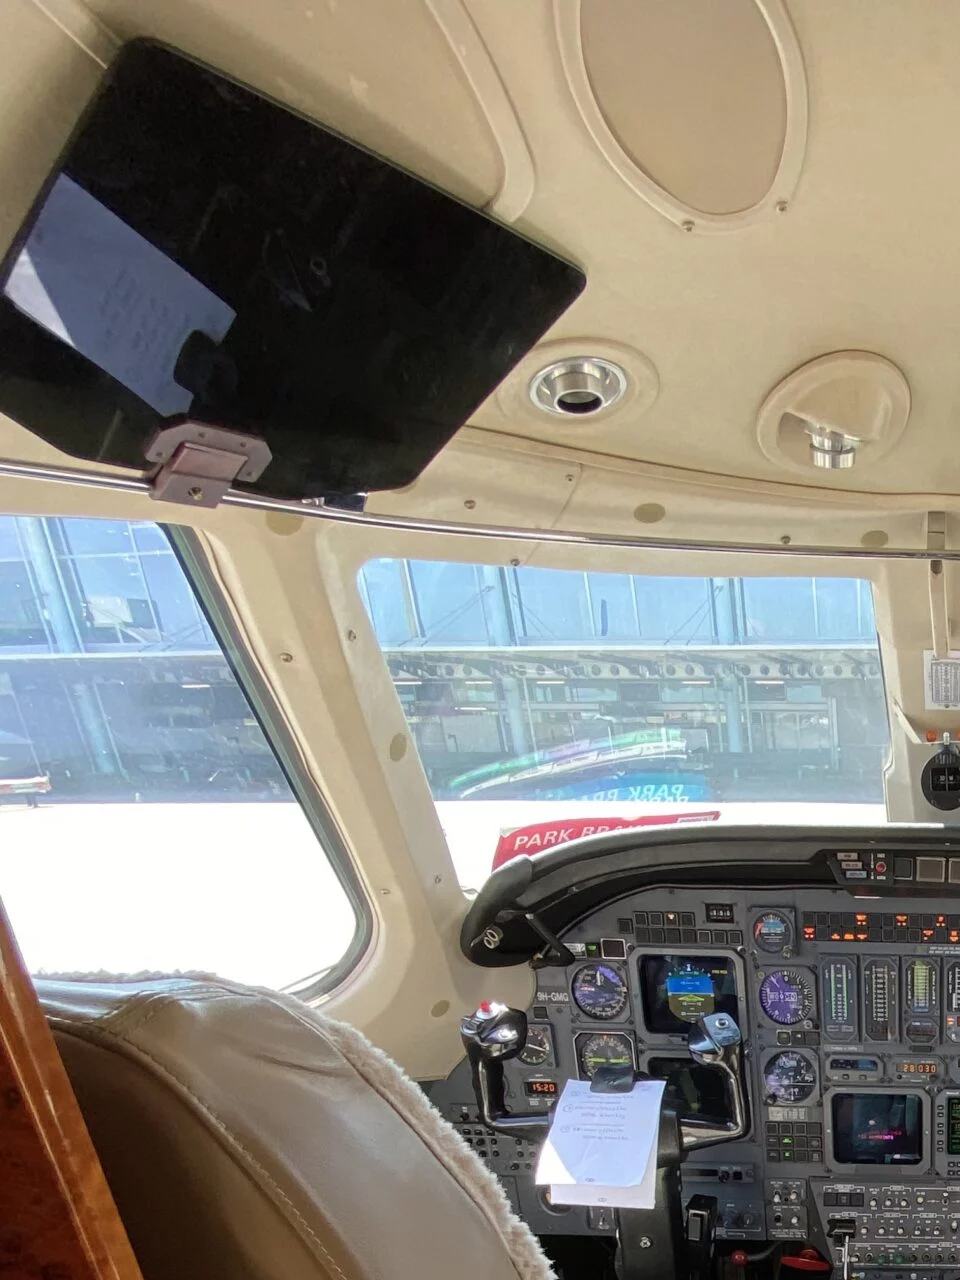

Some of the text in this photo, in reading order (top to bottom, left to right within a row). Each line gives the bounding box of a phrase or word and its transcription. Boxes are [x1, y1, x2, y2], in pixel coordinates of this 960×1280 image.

[514, 827, 571, 851] PARK
[537, 991, 569, 1002] 9H-GMG
[532, 1083, 555, 1092] 15:20
